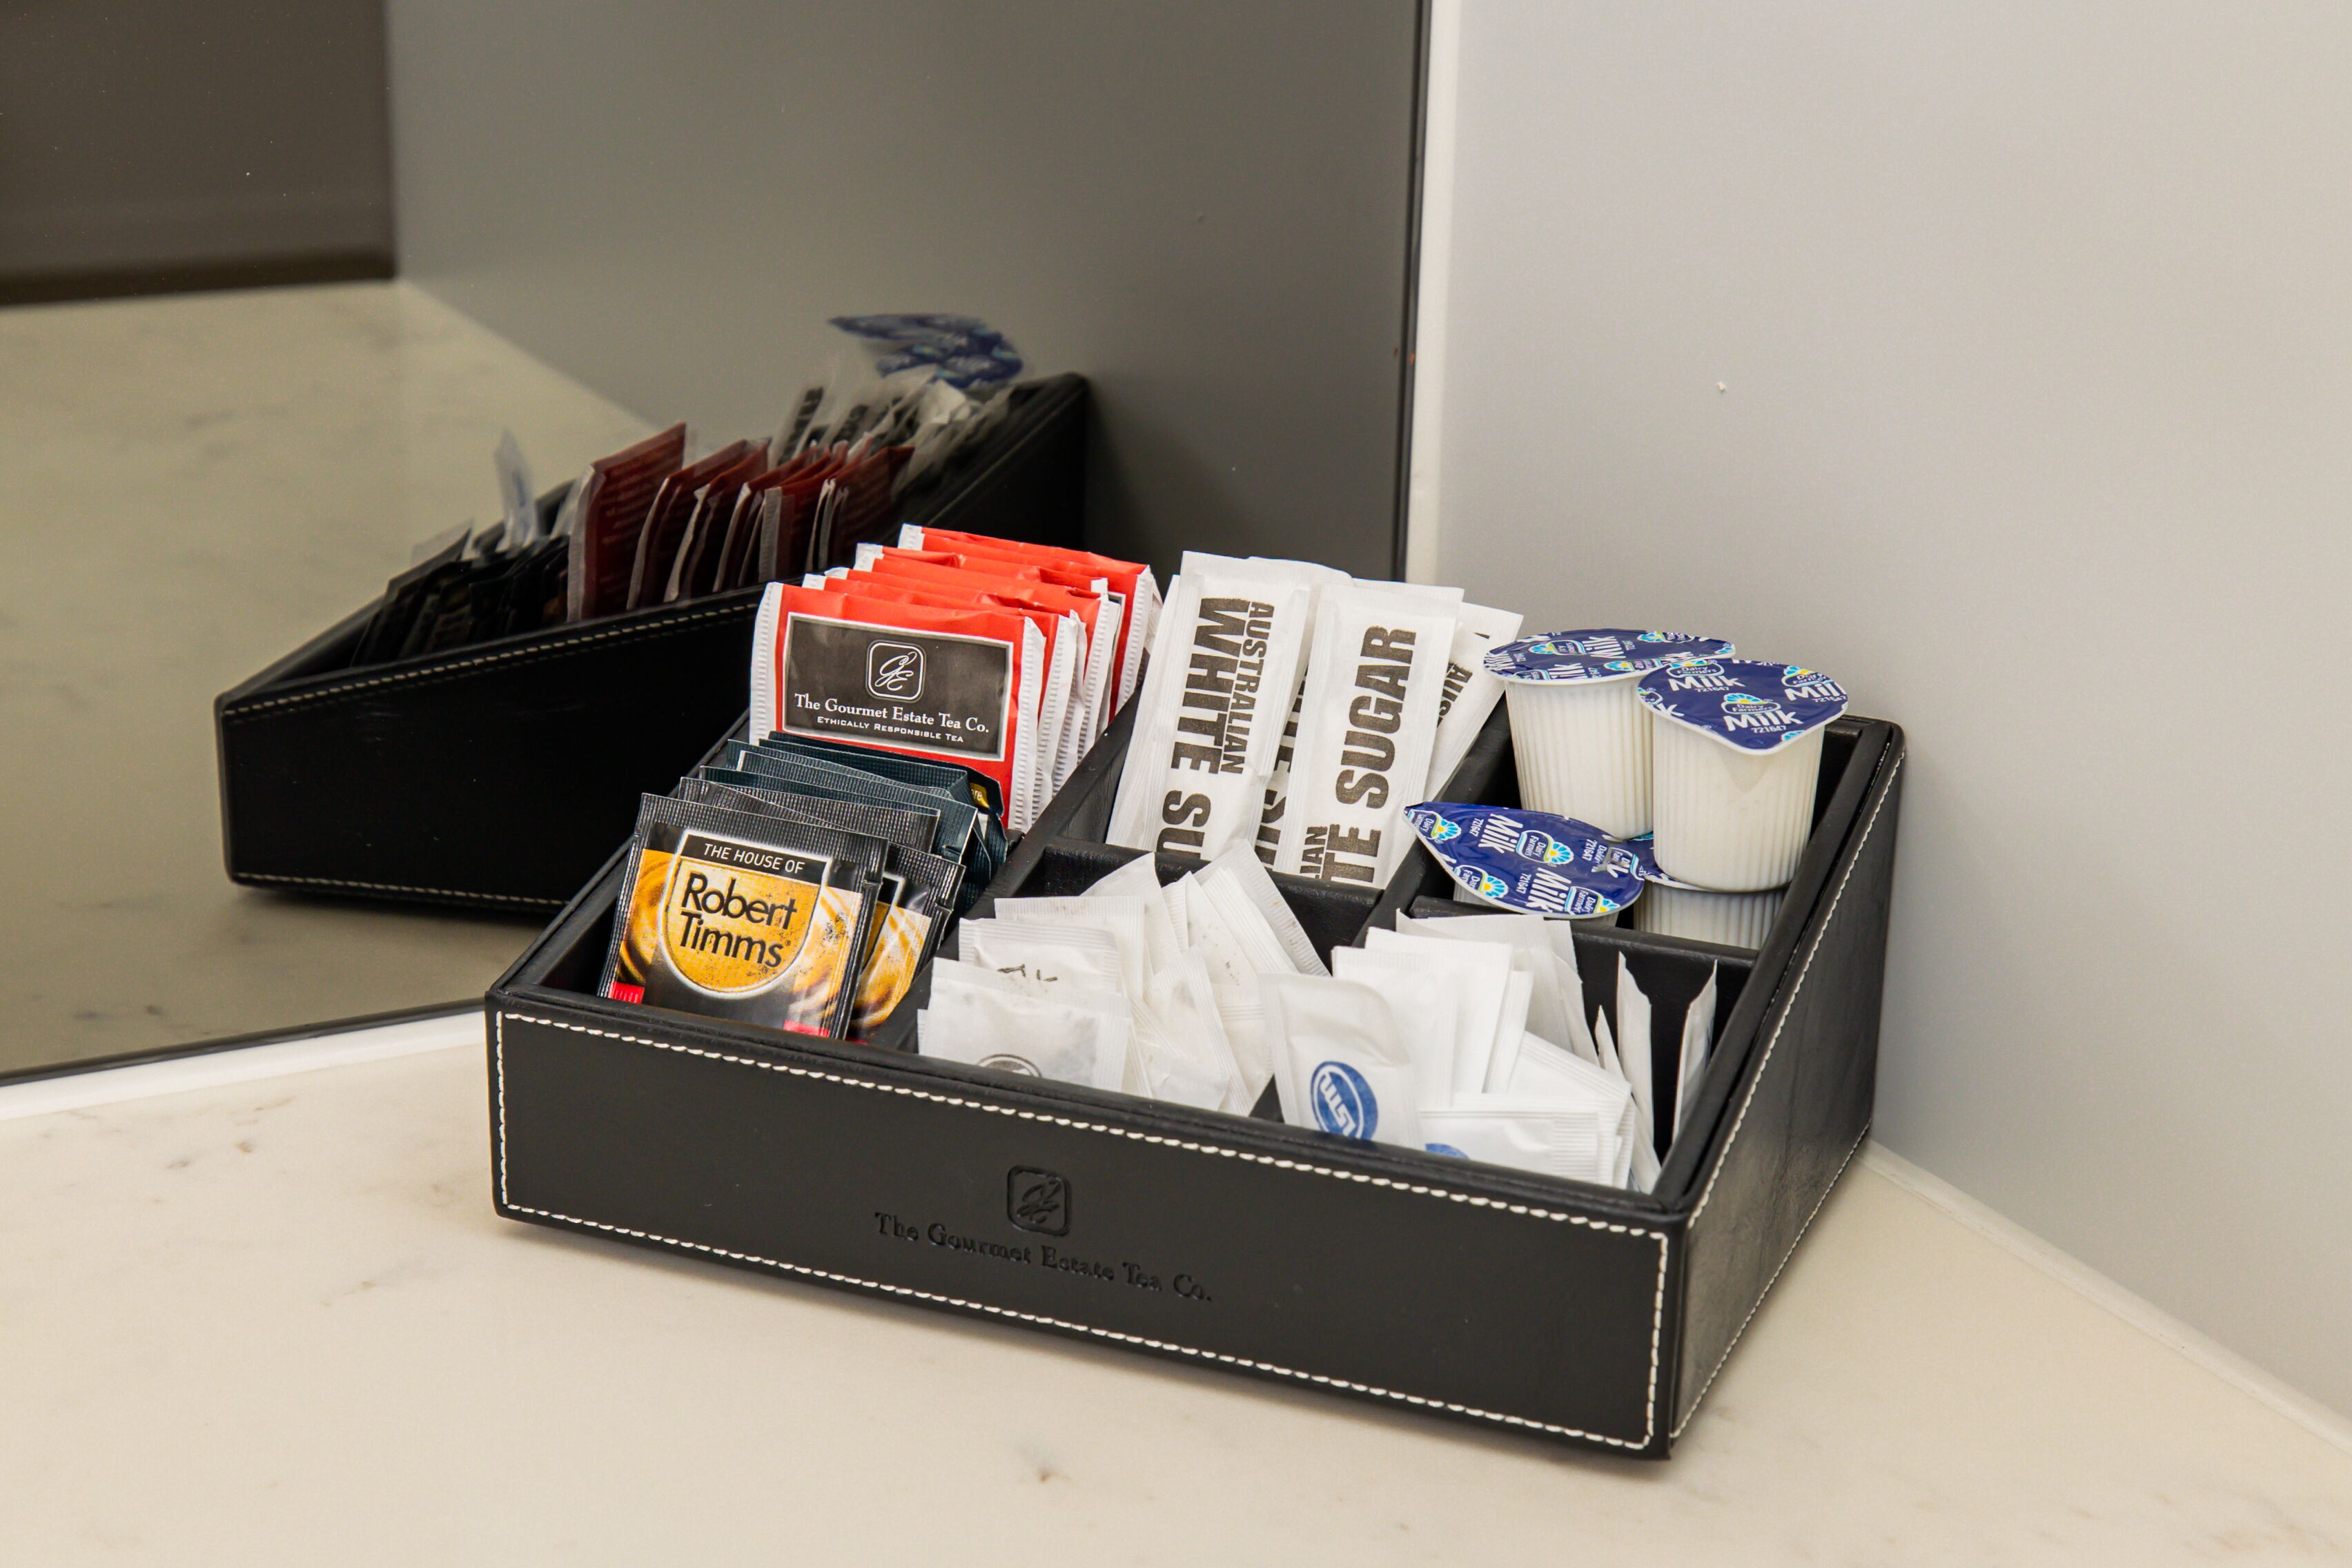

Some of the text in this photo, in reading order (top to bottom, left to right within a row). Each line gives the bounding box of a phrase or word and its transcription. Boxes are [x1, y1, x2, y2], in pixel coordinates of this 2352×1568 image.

[1170, 597, 1251, 775] WHITE
[1220, 600, 1275, 775] AUSTRALIAN
[1668, 676, 1746, 692] Milk
[794, 692, 990, 734] The Gourmet Estate Tea Co.
[817, 716, 964, 743] ETHICALLY RESPONSIBLE TEA
[1335, 625, 1417, 810] SUGAR
[1723, 709, 1804, 732] Milk
[1750, 725, 1787, 734] 721647
[1469, 817, 1484, 838] 721647
[1478, 813, 1524, 854] Milk
[1525, 835, 1540, 856] Farmers
[704, 843, 806, 874] THE HOUSE OF
[1536, 841, 1547, 858] Dairy
[681, 872, 798, 930] Robert
[1516, 872, 1532, 894] 721647
[1525, 867, 1572, 913] Milk
[680, 910, 785, 968] Timms
[874, 1211, 1212, 1302] The Gourmet Estate Tea Co.
